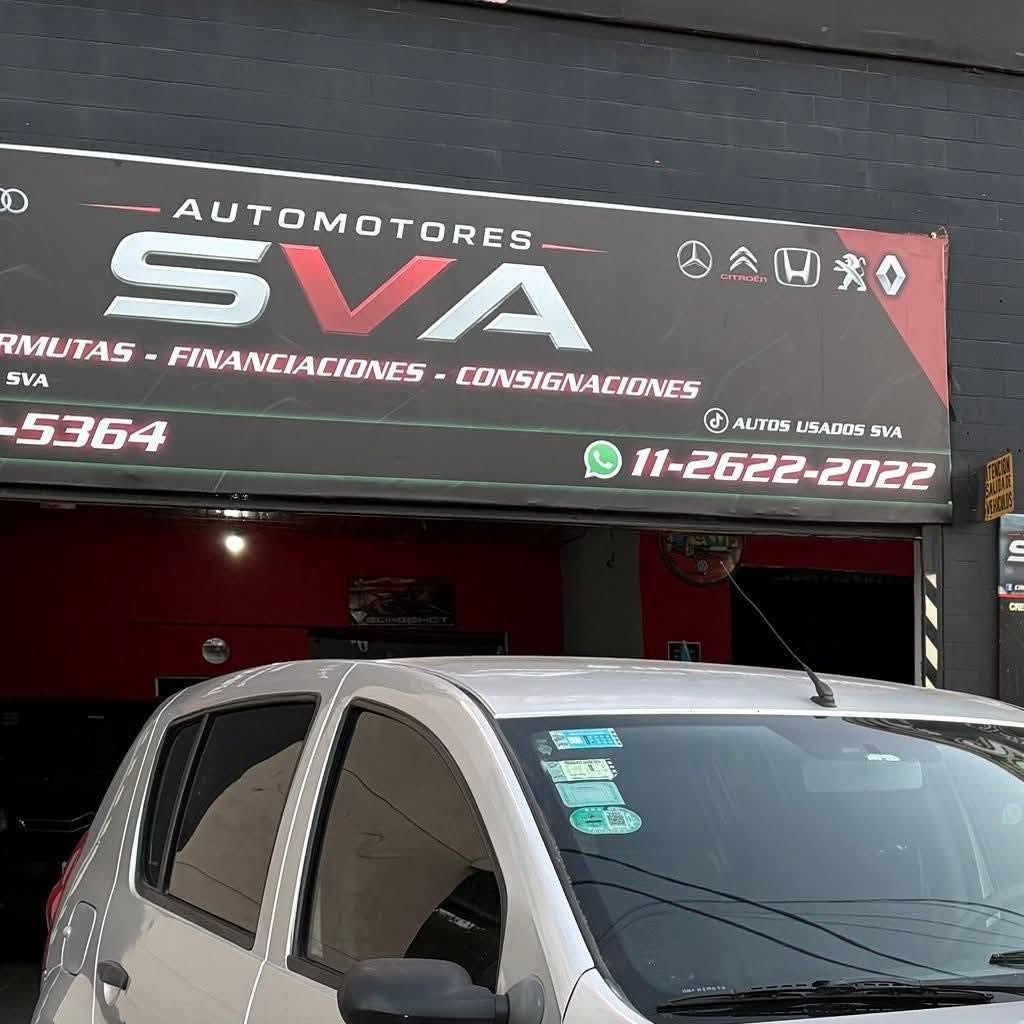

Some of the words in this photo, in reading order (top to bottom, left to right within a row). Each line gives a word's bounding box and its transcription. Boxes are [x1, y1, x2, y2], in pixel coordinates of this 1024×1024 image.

[172, 198, 533, 250] AUTOMOTORES
[104, 231, 592, 353] SVA
[6, 371, 49, 388] SVA
[168, 346, 426, 383] FINANCIACIONES
[456, 366, 702, 401] CONSIGNACIONES
[732, 416, 791, 433] AUTOS
[796, 421, 865, 437] USADOS
[869, 424, 903, 438] SVA
[630, 448, 936, 491] 11-2622-2022
